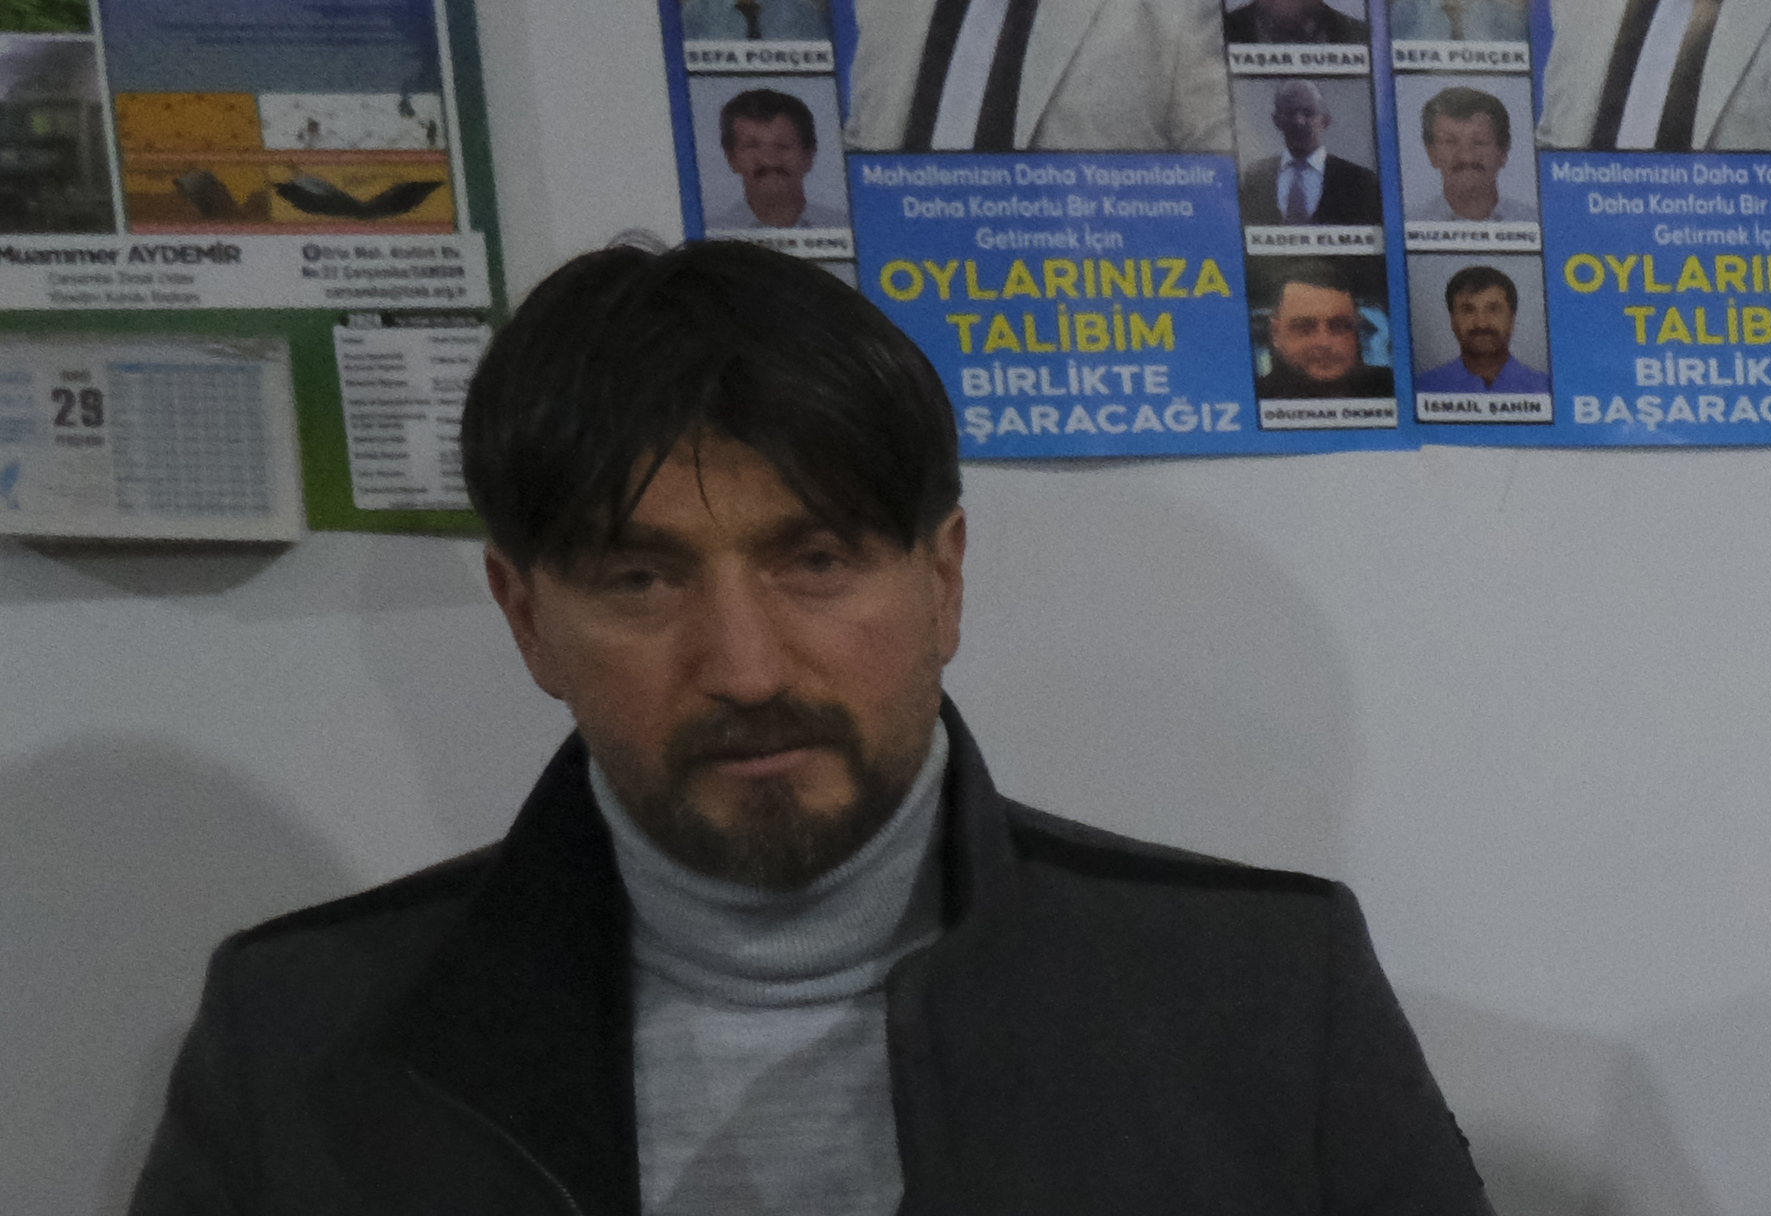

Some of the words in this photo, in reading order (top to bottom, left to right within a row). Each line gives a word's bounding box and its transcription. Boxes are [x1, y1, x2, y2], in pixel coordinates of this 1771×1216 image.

[863, 164, 1011, 186] Mahallemizin
[1015, 163, 1076, 185] Daha
[1552, 162, 1688, 183] Mahallemizin
[1693, 163, 1748, 183] Daha
[904, 195, 965, 218] Daha
[970, 195, 1062, 218] Konforlu
[1067, 195, 1098, 218] Bir
[1103, 196, 1194, 218] Konuma
[1587, 193, 1644, 215] Daha
[1649, 193, 1735, 215] Konforlu
[1740, 194, 1767, 215] Bir
[976, 226, 1079, 249] Getirmek
[1654, 224, 1748, 246] Getirmek
[879, 257, 1232, 300] OYLARINIZA
[945, 302, 1176, 353] TALİBİM
[961, 358, 1171, 397] BİRLİKTE
[51, 386, 104, 429] 29
[958, 396, 1242, 445] ŞARACAĞIZ
